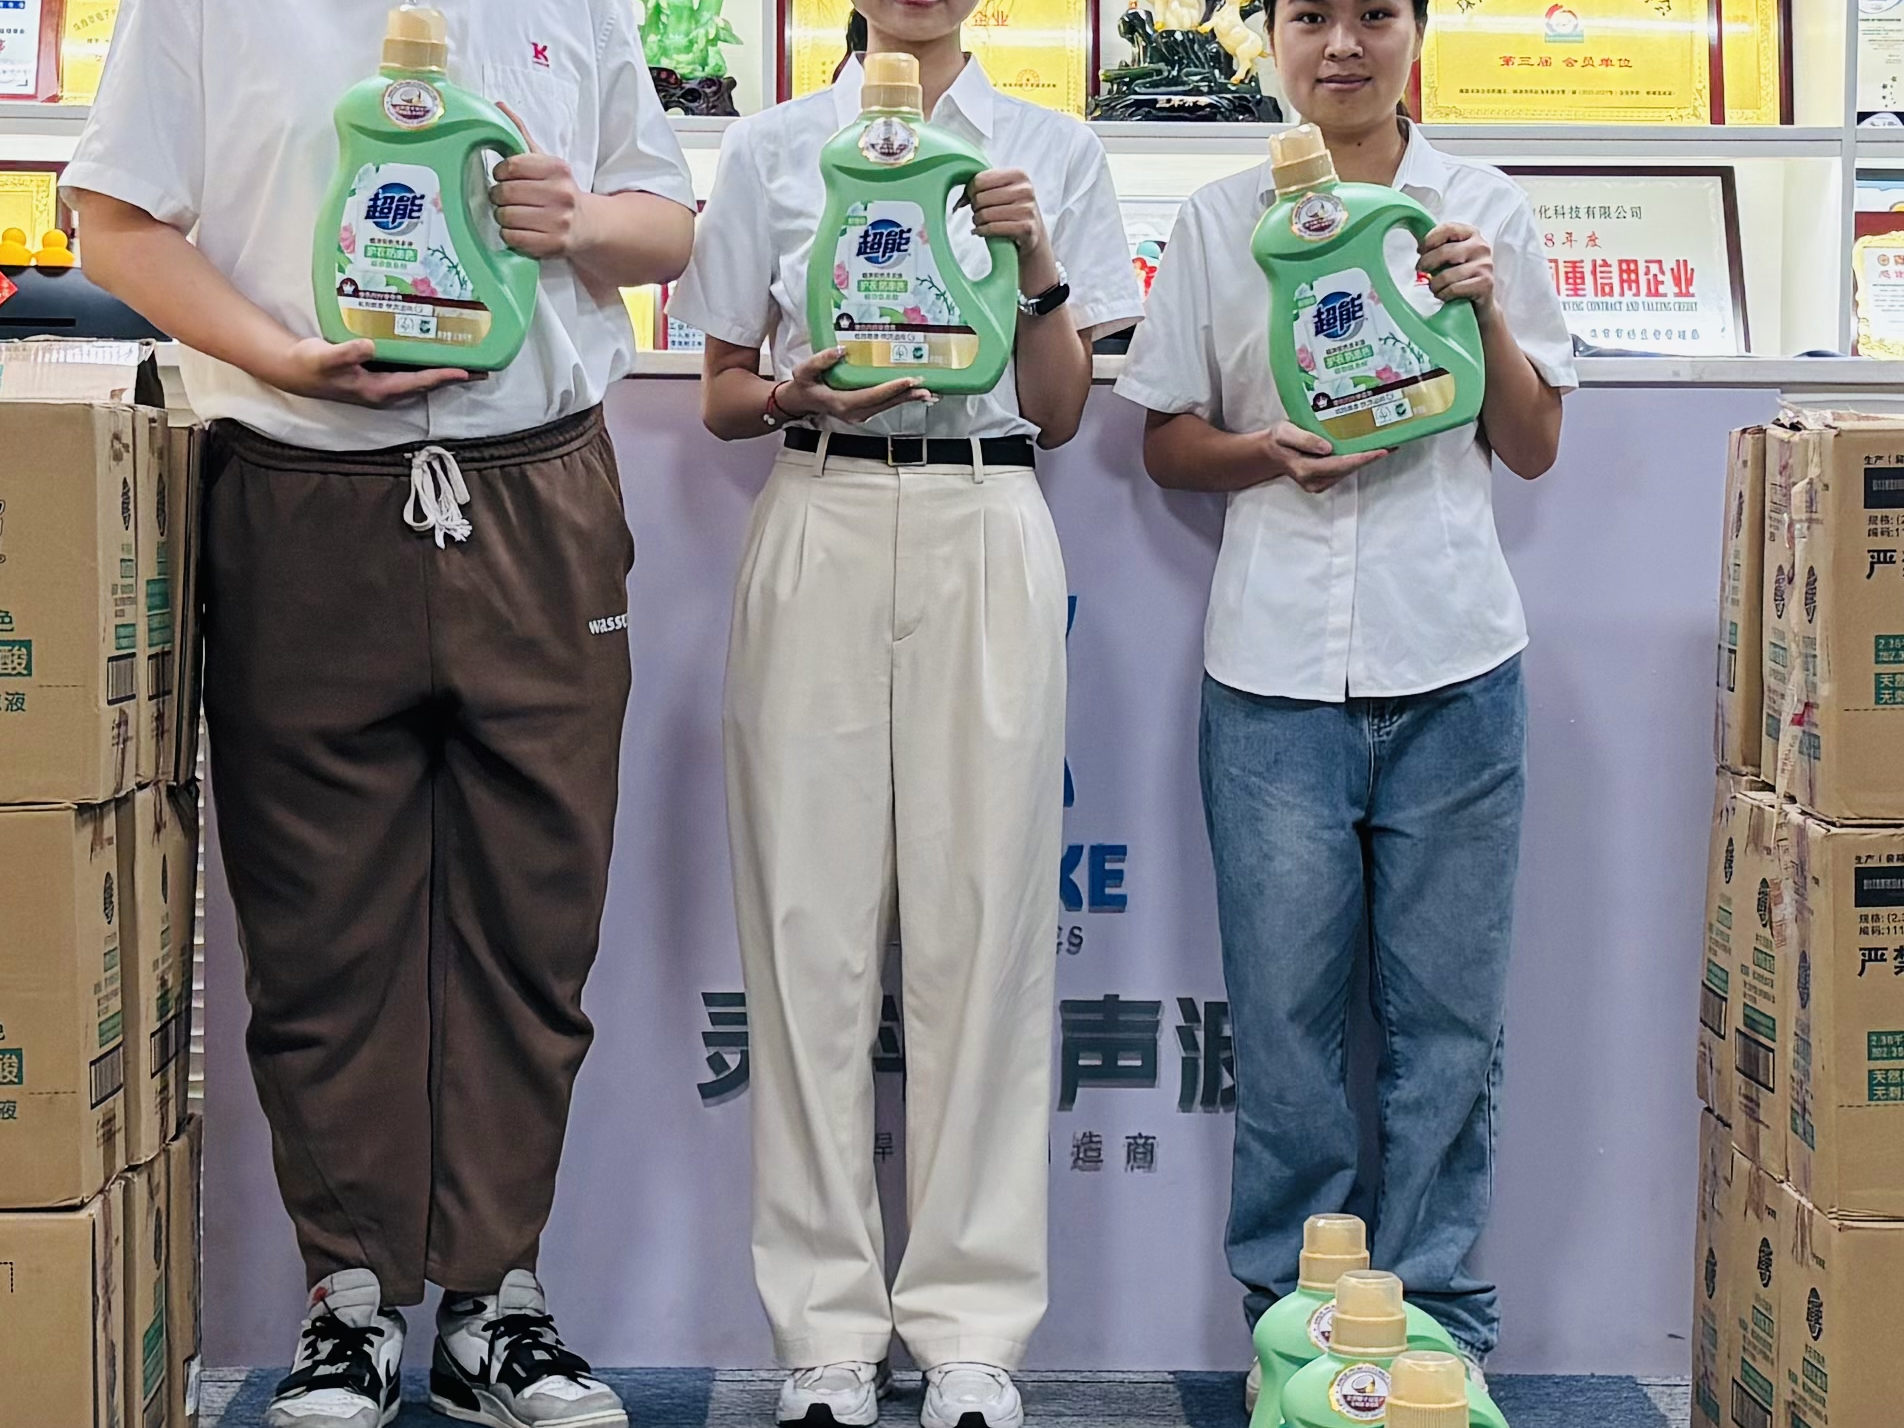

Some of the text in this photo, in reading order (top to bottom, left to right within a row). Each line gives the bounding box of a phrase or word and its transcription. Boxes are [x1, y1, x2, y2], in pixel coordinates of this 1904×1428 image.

[1499, 55, 1633, 68] 第三届 会员单位
[1532, 205, 1643, 220] 化科技有限公司
[1587, 301, 1622, 311] CONTRACT
[1626, 301, 1639, 311] AND
